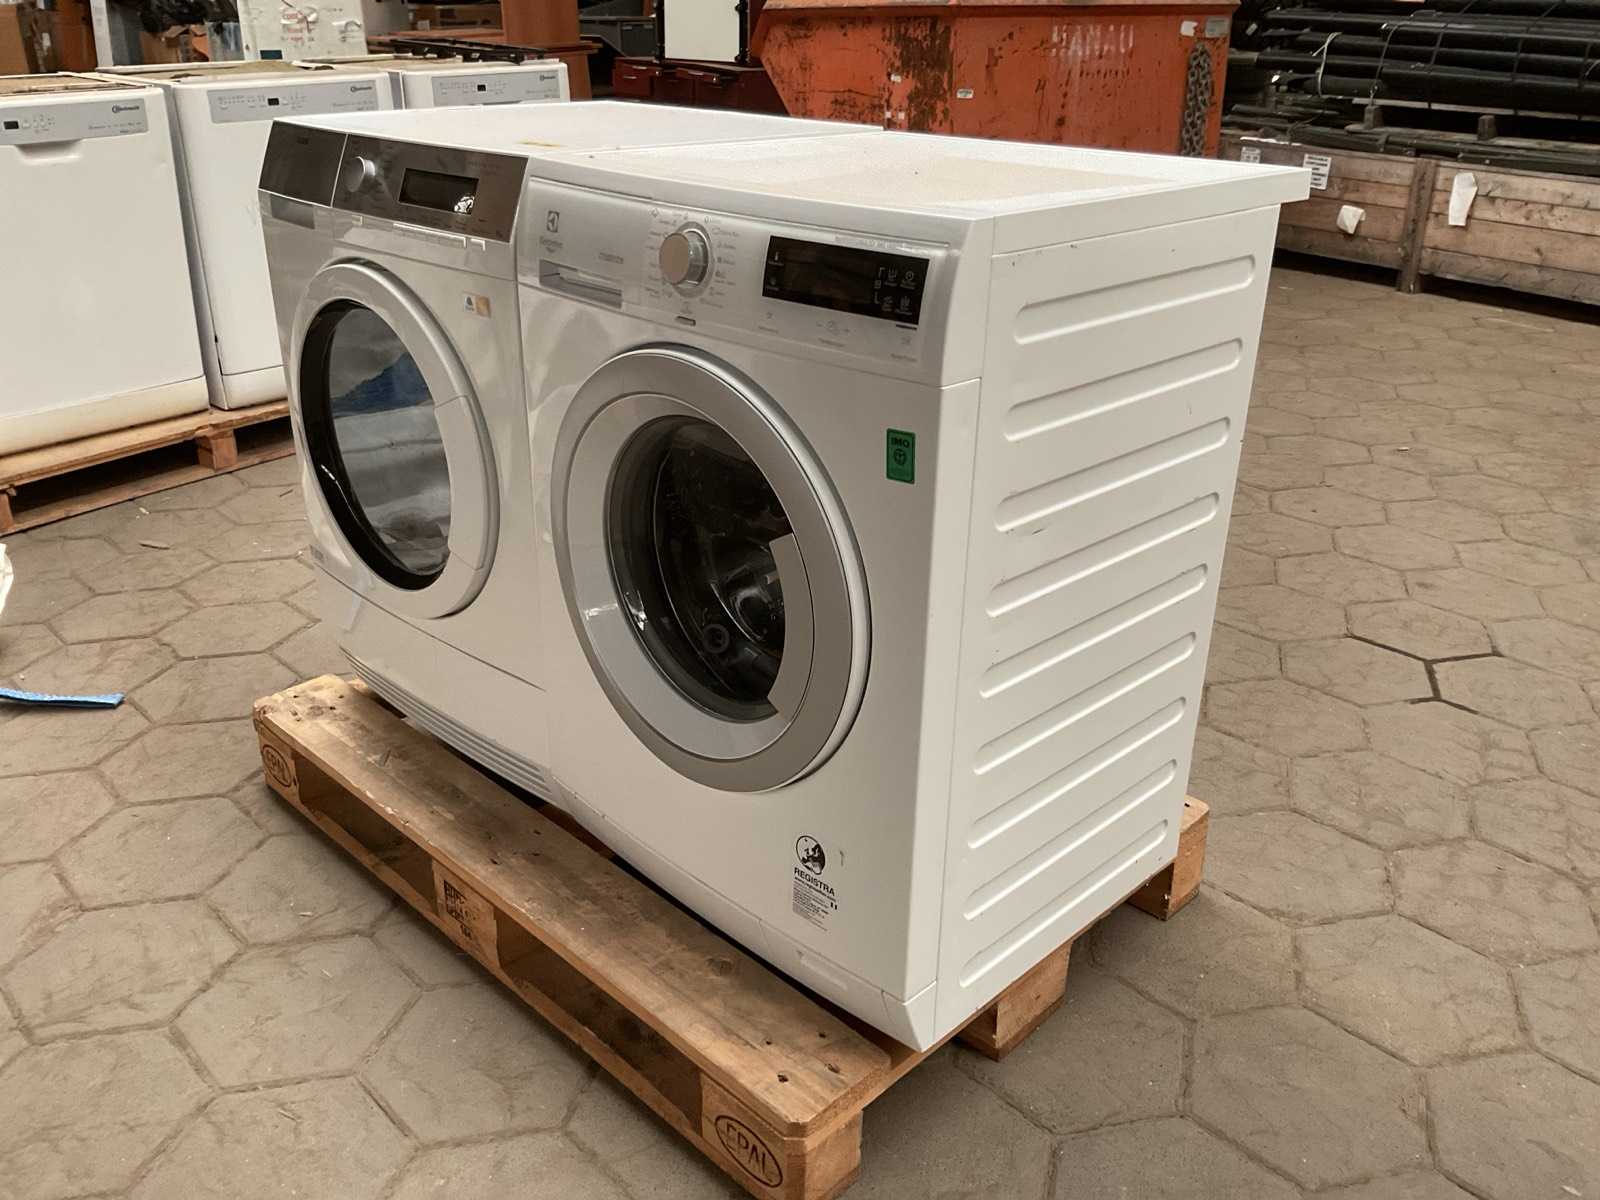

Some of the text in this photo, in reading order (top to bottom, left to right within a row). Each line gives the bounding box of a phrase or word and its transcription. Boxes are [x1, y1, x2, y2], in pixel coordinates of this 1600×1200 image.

[1051, 24, 1135, 57] HANAU
[793, 867, 836, 897] REGISTRA
[726, 1120, 774, 1184] EPAL
